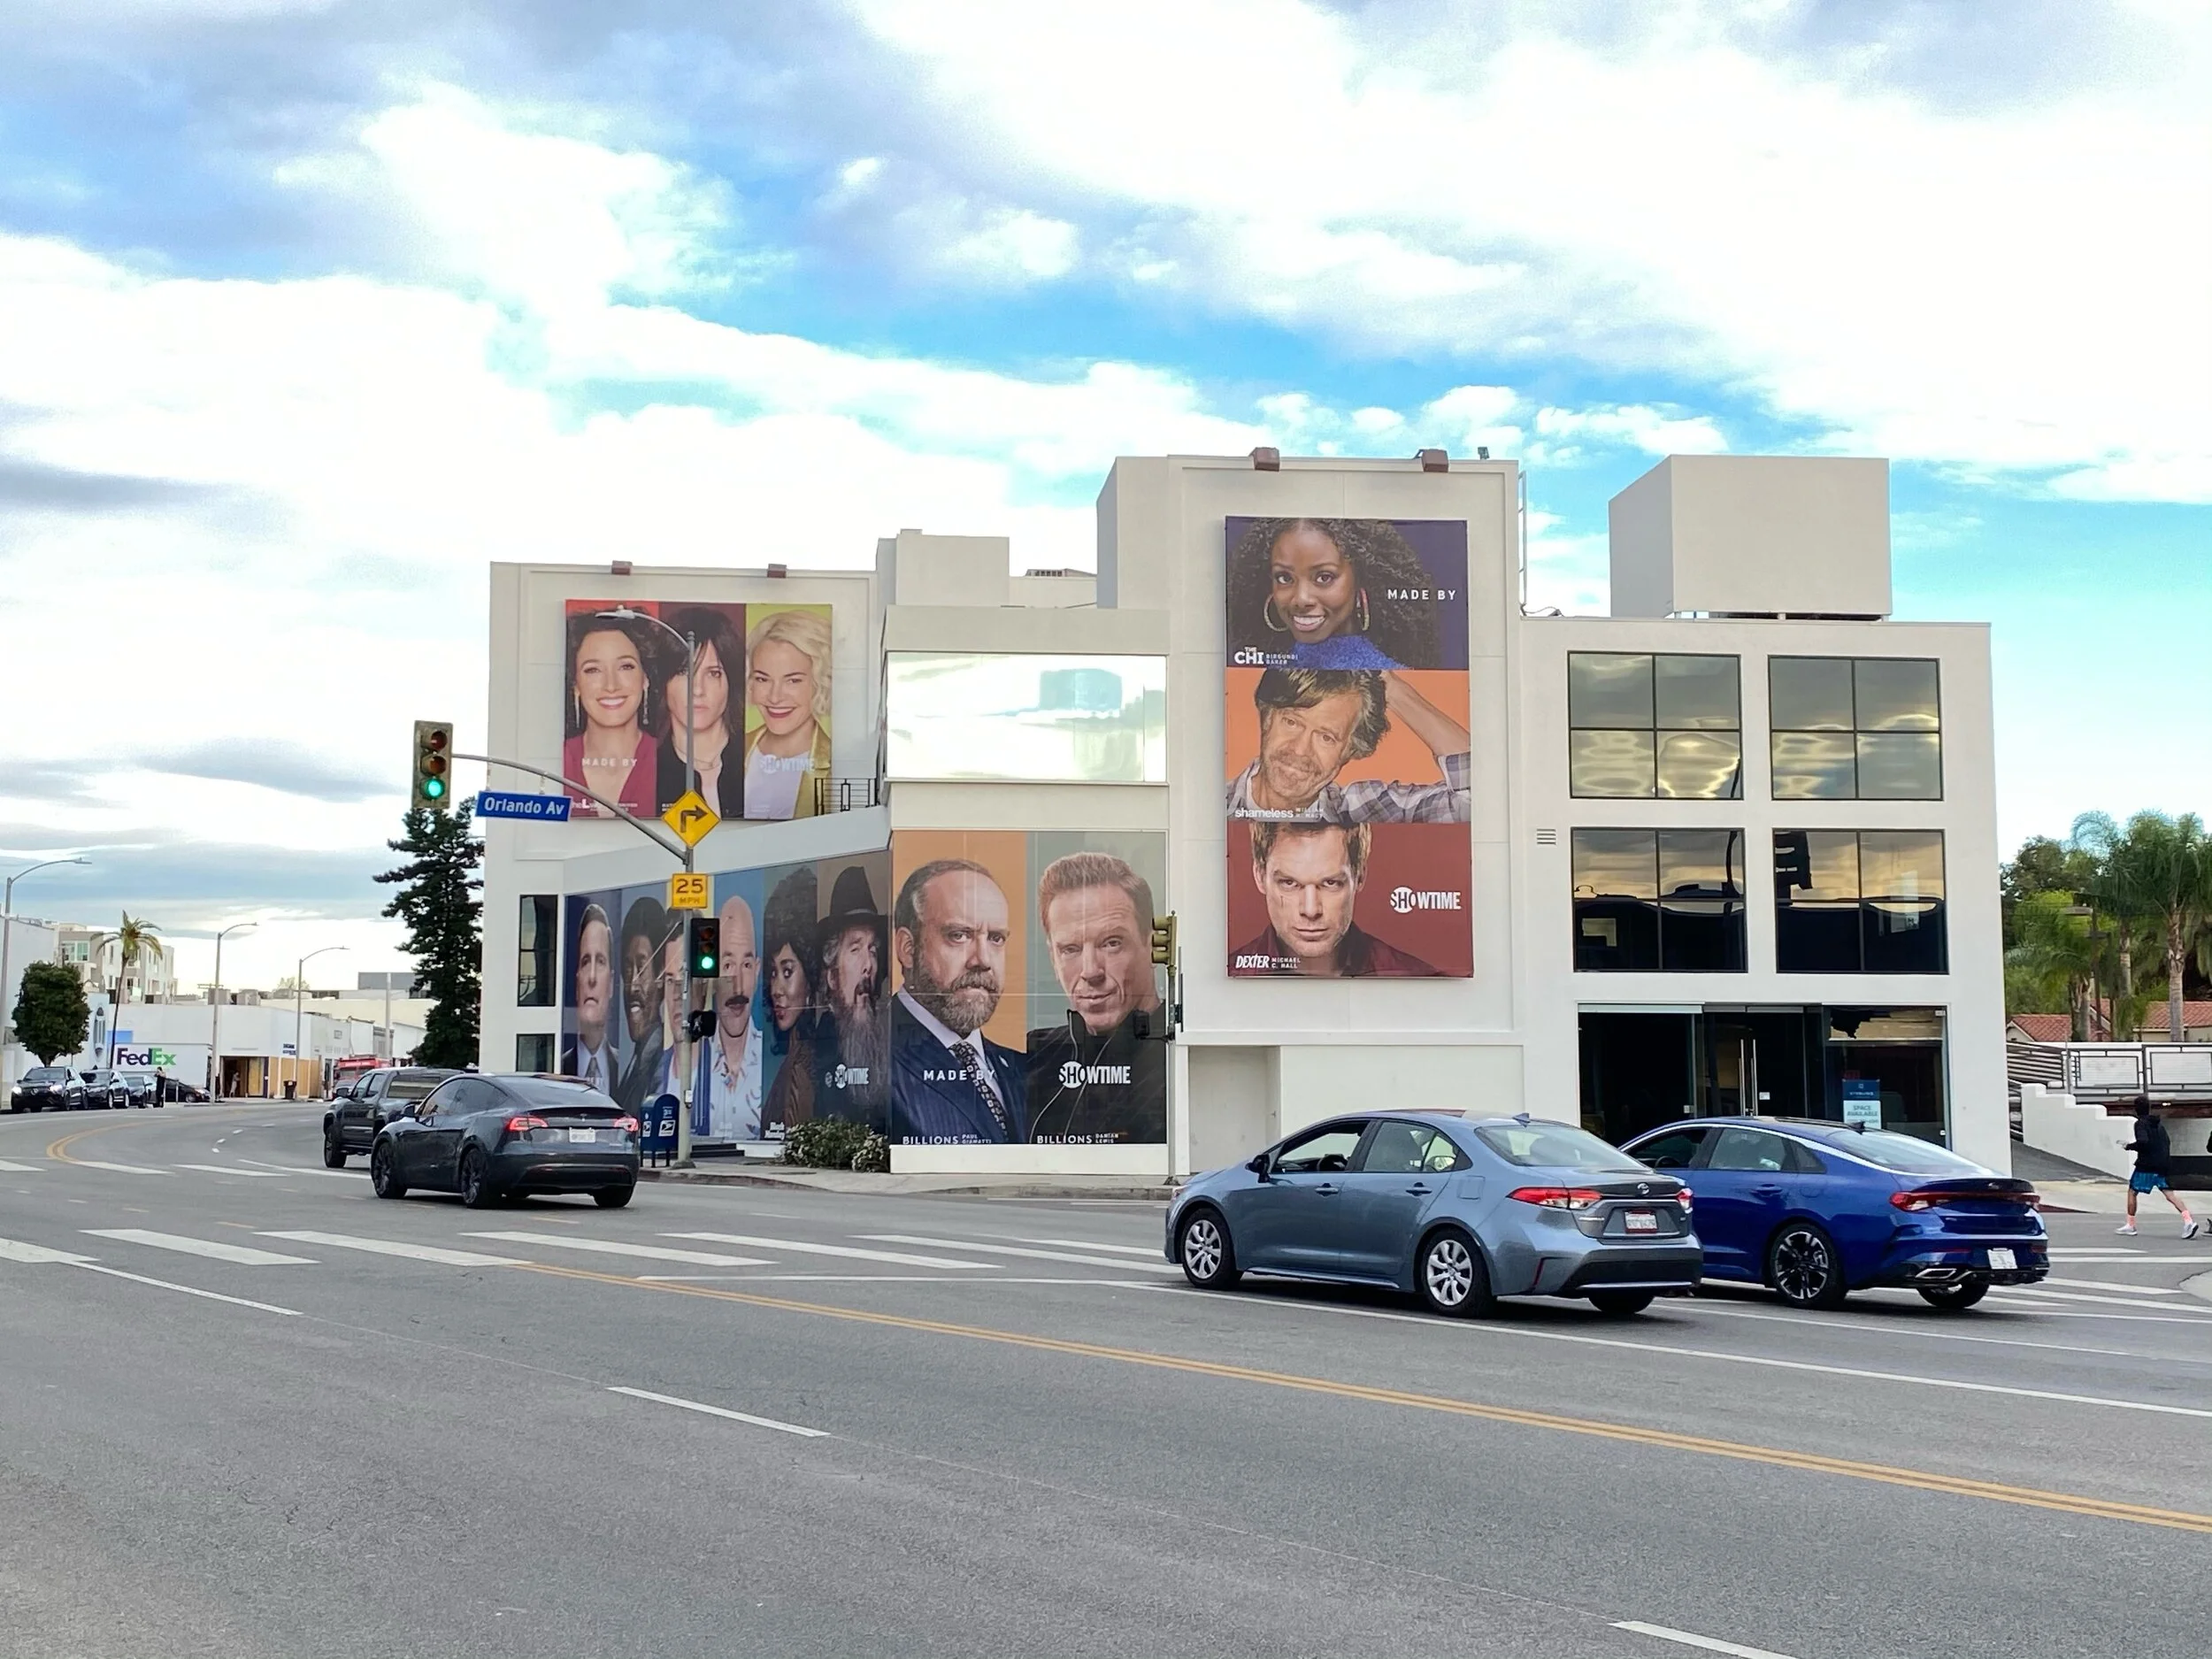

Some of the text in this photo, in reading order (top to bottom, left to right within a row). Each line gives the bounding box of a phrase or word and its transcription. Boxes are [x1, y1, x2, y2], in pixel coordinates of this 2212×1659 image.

[1387, 589, 1455, 601] MADE BY
[1234, 651, 1264, 664] CHI
[581, 758, 637, 767] MADE BY
[759, 754, 815, 774] SHOWTIME
[484, 797, 565, 815] Orlando Av
[1235, 807, 1294, 818] shameless
[676, 879, 703, 894] 25
[1390, 887, 1462, 913] SHOWTIME
[1235, 954, 1271, 969] DEXTER
[116, 1048, 177, 1065] FedEx
[834, 1064, 869, 1088] SHOWTIME
[923, 1070, 995, 1080] MADE BY
[1058, 1061, 1131, 1088] SHOWTIME
[902, 1136, 958, 1145] BILLIONS
[1037, 1135, 1092, 1144] BILLIONS
